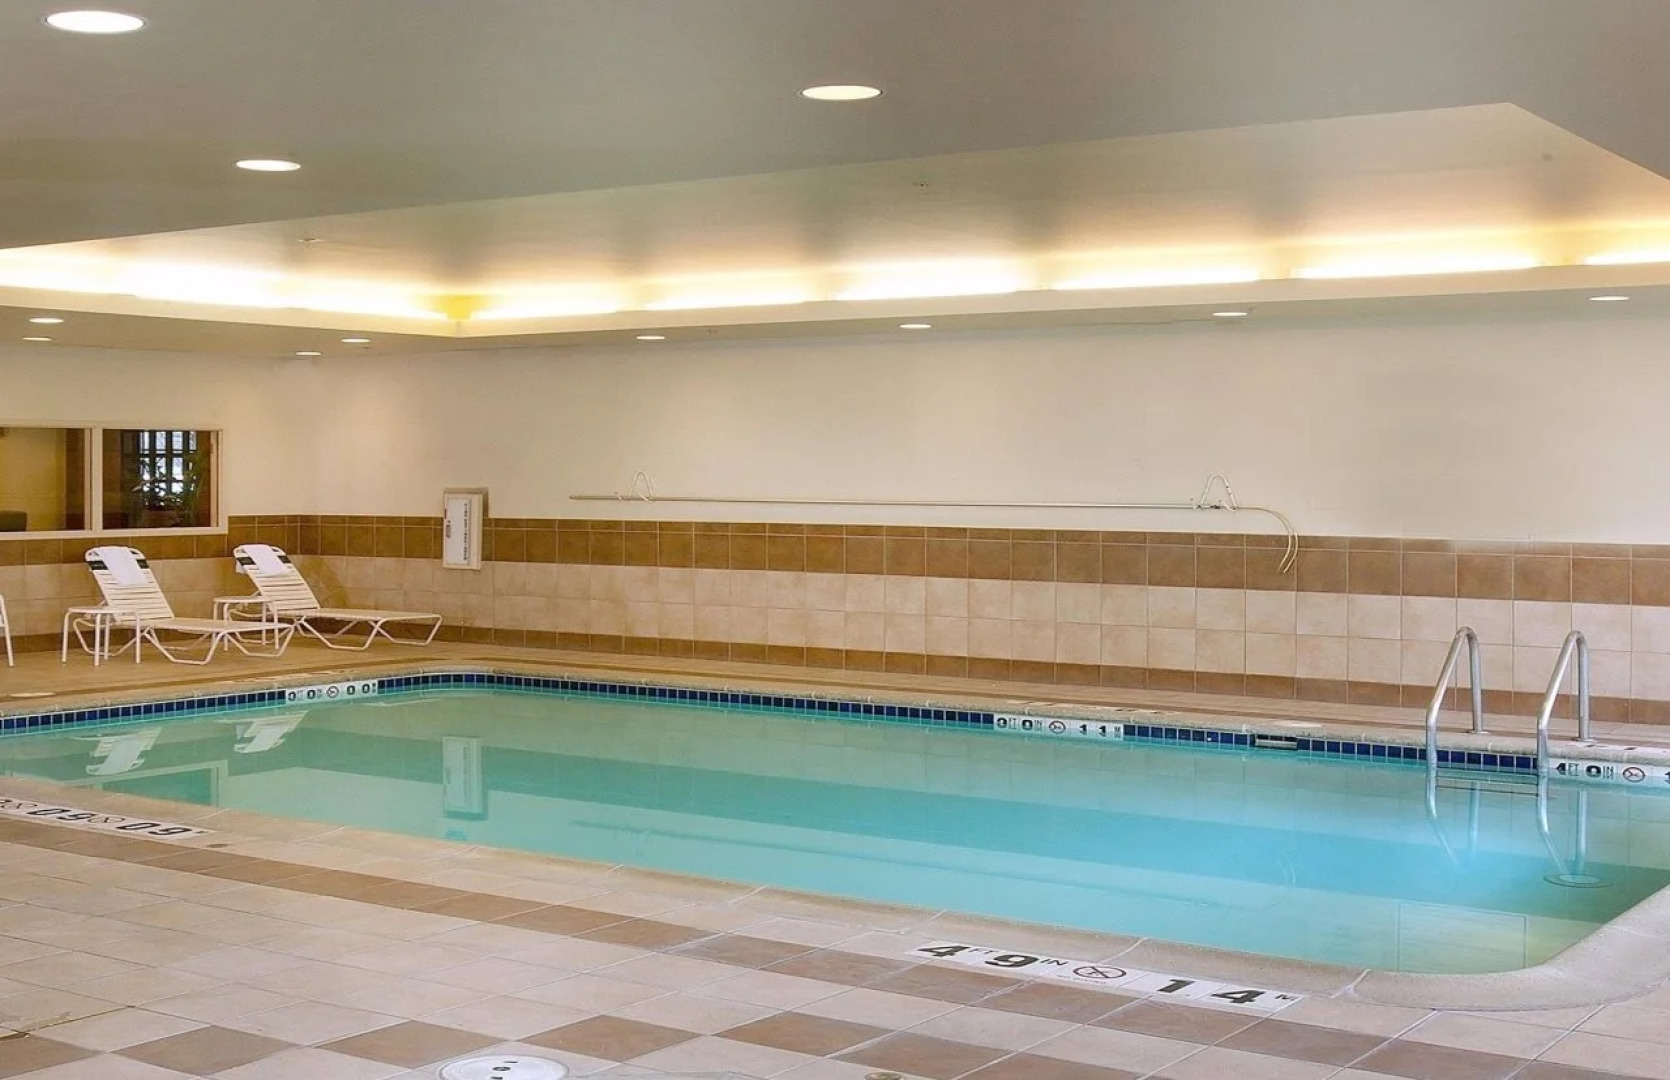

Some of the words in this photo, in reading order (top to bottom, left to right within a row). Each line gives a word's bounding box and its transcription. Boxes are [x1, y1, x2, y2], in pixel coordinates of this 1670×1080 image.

[917, 945, 971, 957] 4
[984, 954, 1040, 968] 9
[1040, 958, 1068, 966] IN
